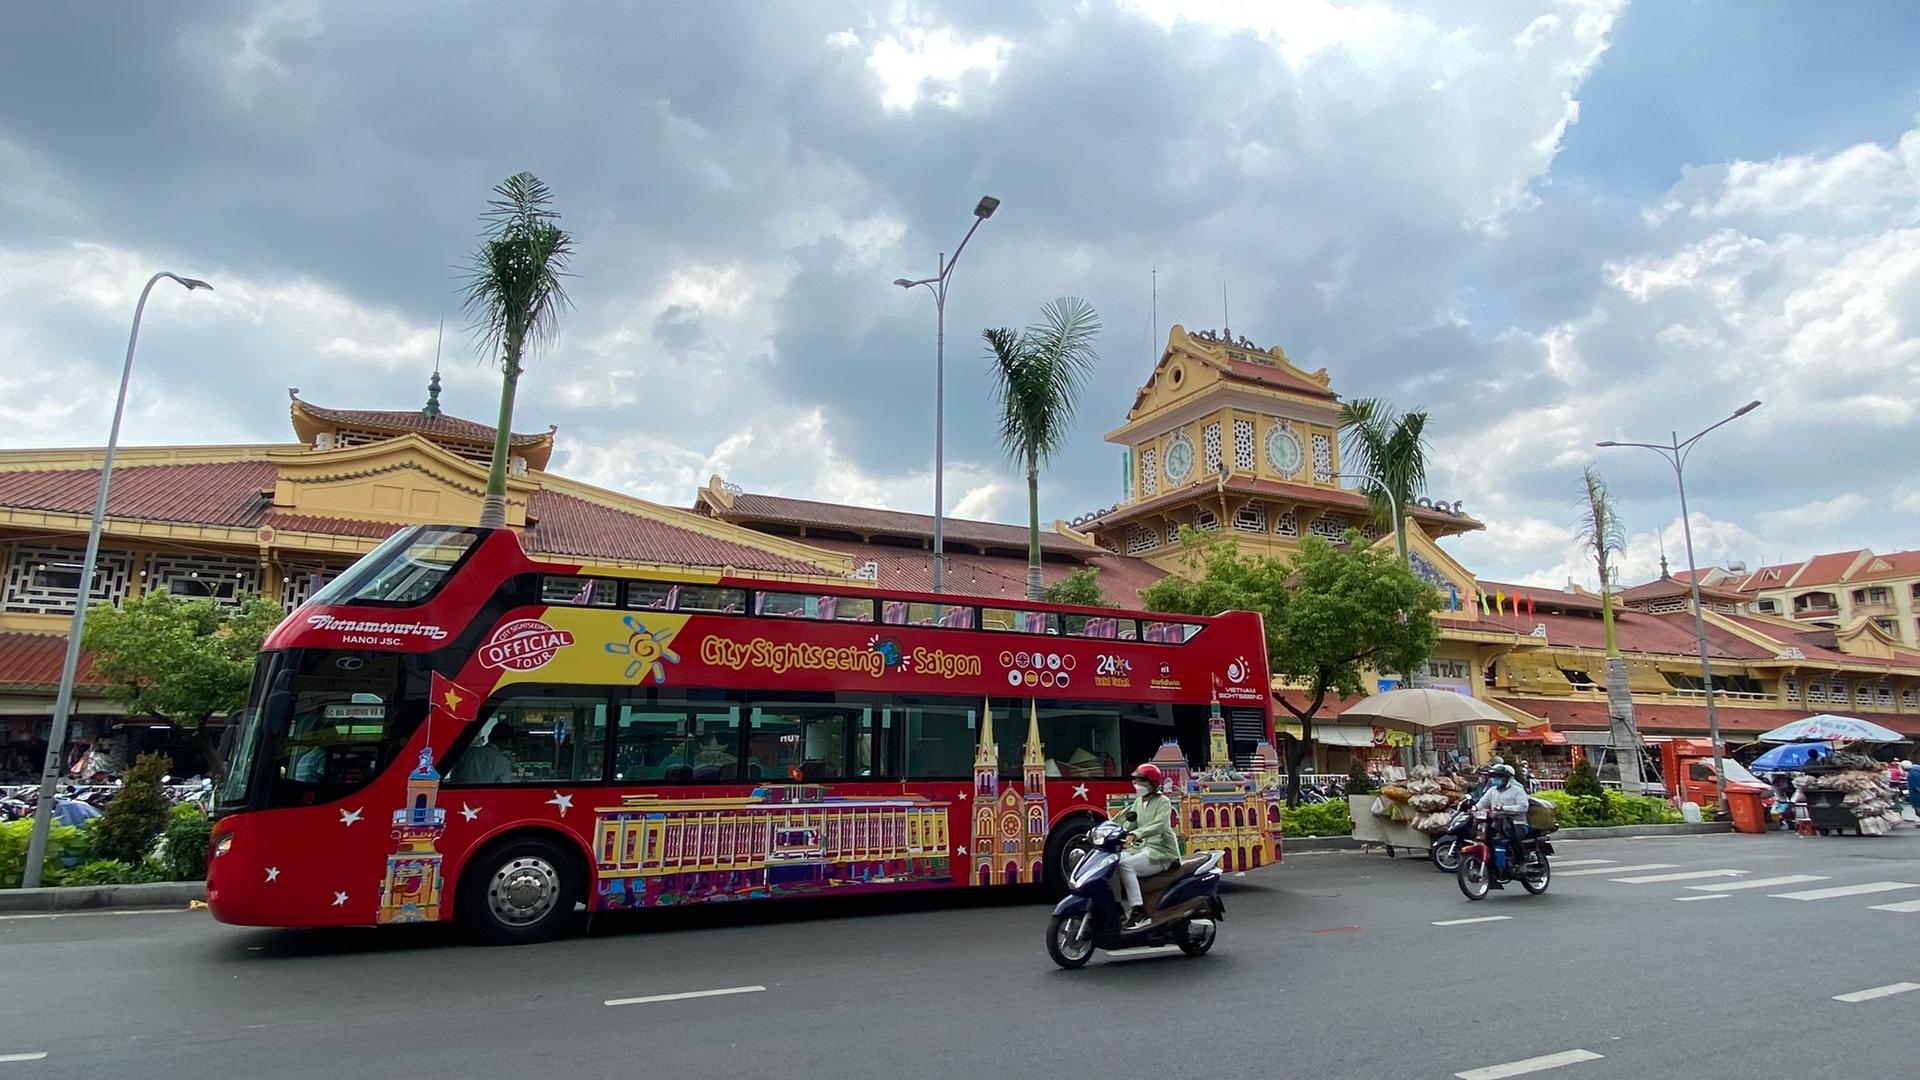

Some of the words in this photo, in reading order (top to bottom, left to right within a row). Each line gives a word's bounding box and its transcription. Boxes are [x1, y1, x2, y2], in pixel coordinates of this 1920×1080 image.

[342, 635, 378, 645] HANOI
[379, 637, 404, 647] JSC.
[489, 632, 571, 662] OFFICIAL
[516, 651, 552, 668] TOUR
[913, 647, 981, 678] Saigon
